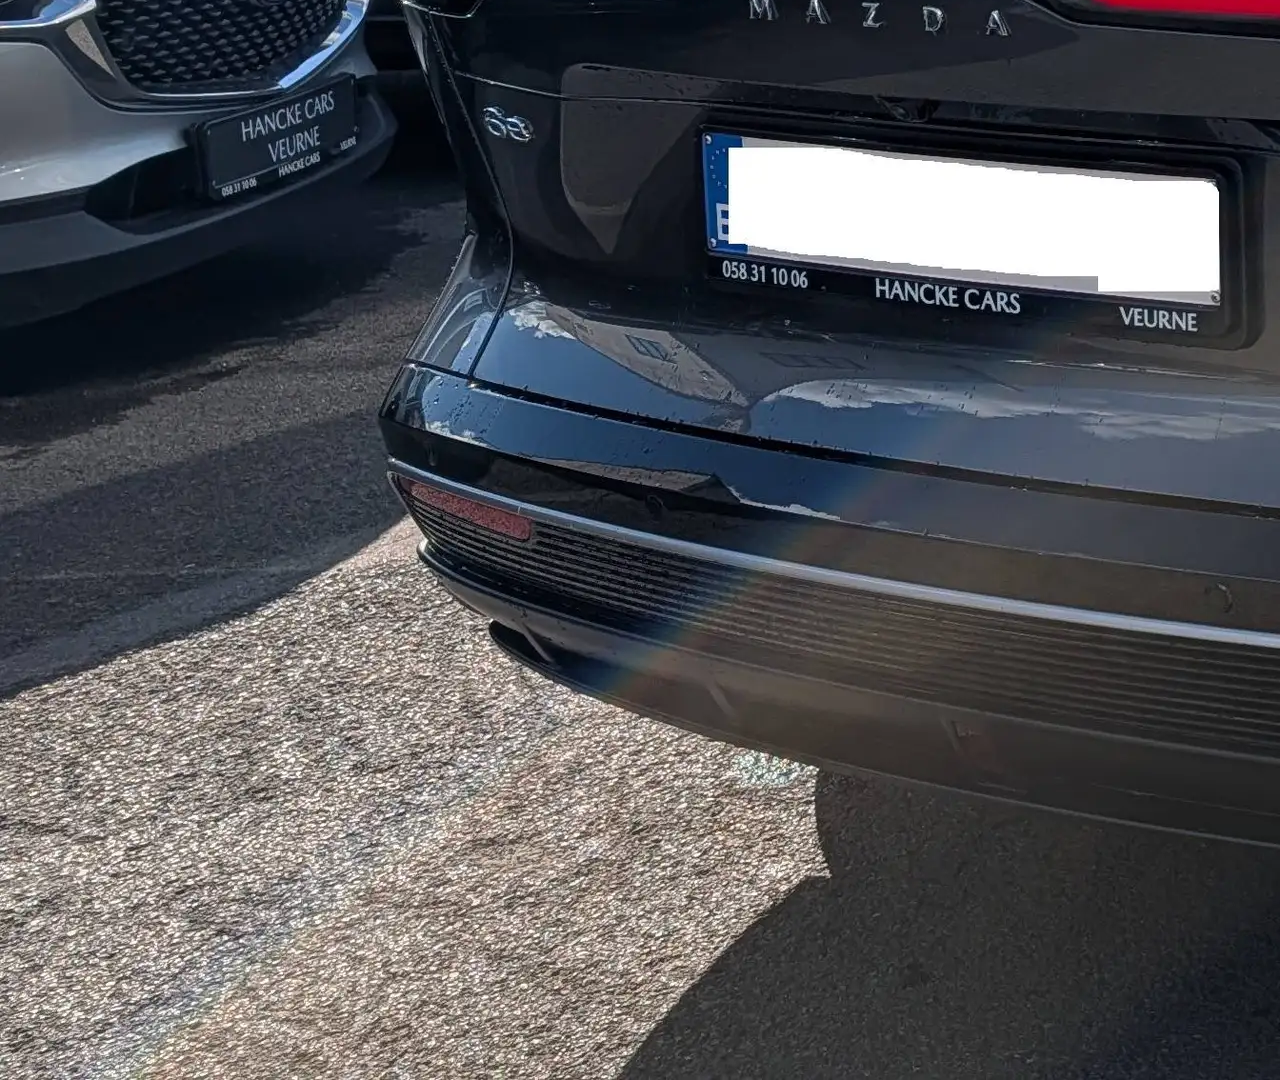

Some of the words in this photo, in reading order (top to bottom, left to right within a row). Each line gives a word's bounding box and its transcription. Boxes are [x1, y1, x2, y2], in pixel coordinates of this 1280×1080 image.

[241, 103, 303, 142] HANCKE
[304, 90, 335, 120] CARS
[267, 126, 321, 163] VEURNE
[278, 159, 304, 178] HANCKE
[304, 151, 321, 168] CARS
[722, 260, 748, 280] 058
[751, 264, 766, 283] 31
[771, 267, 788, 286] 10
[791, 270, 809, 289] 06
[875, 277, 960, 308] HANCKE
[964, 288, 1021, 314] CARS
[1118, 306, 1199, 332] VEURNE
